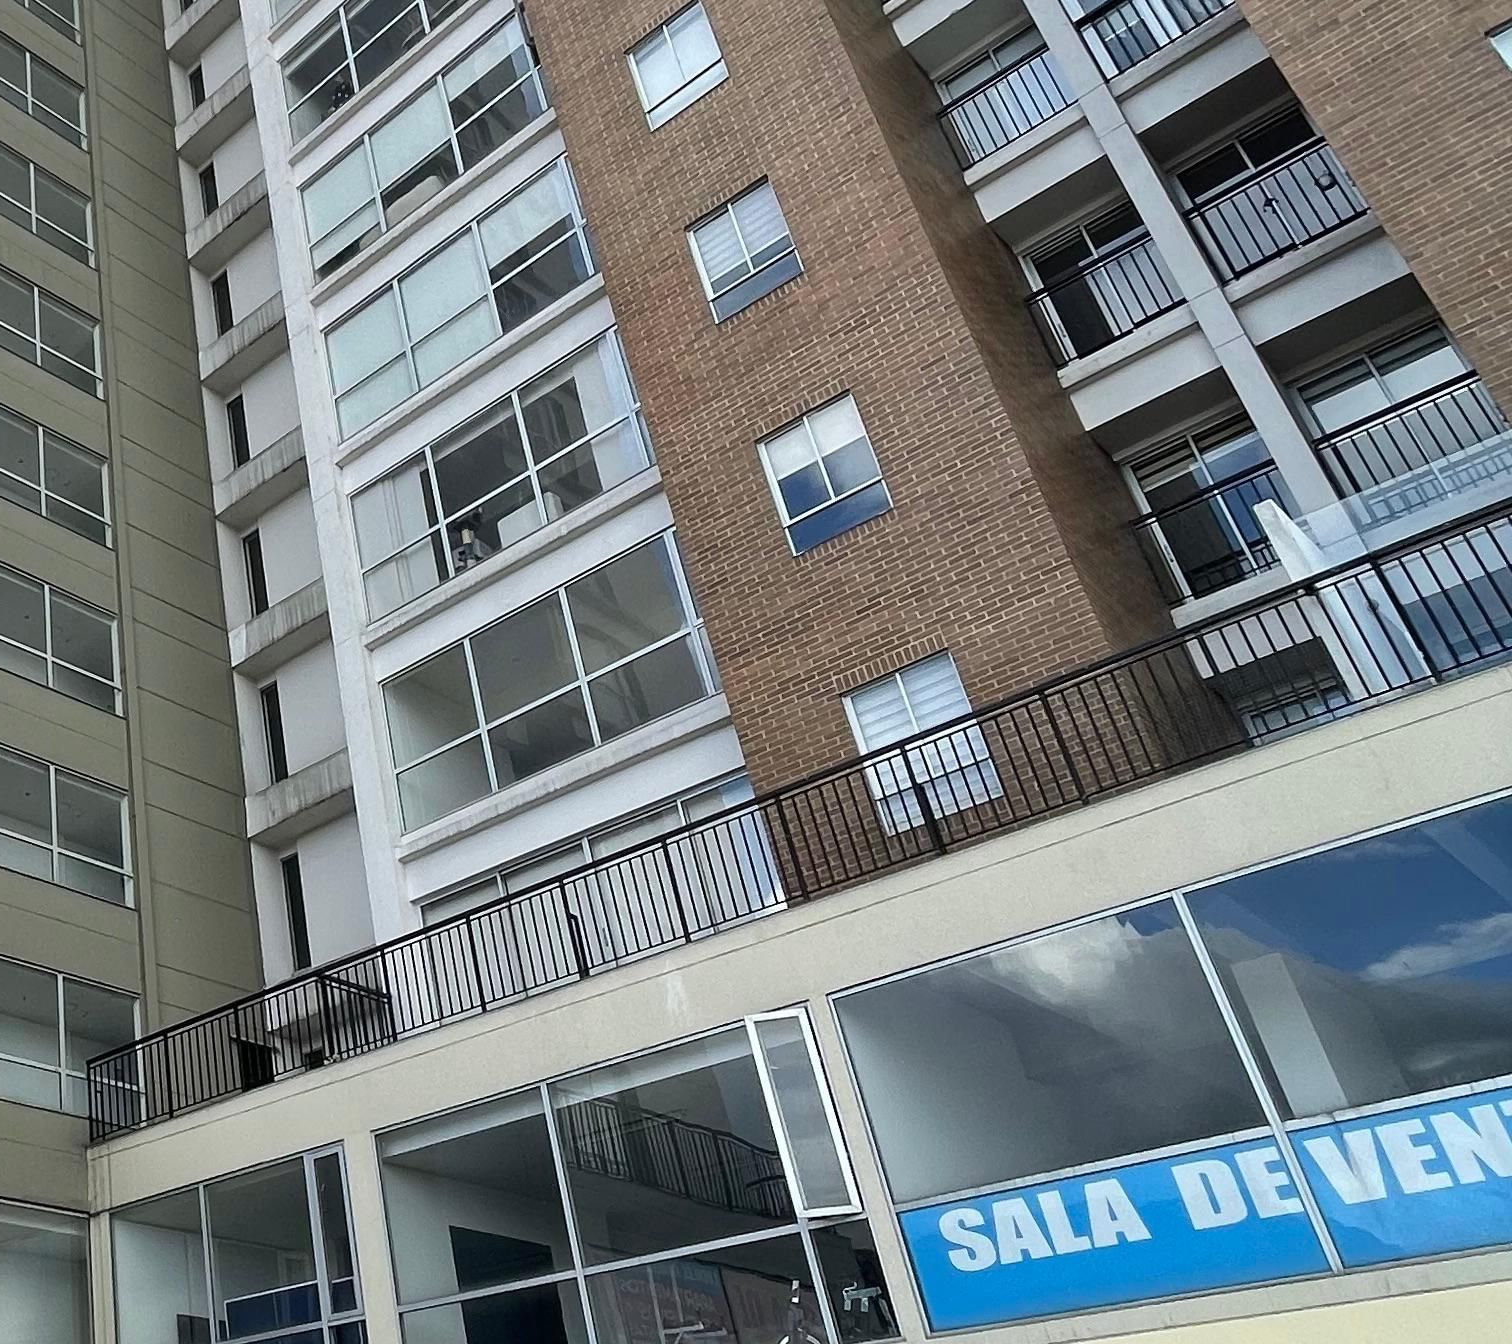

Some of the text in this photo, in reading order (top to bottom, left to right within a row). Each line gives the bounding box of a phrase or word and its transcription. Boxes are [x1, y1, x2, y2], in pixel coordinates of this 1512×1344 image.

[938, 1100, 1512, 1272] SALA DE VEN
